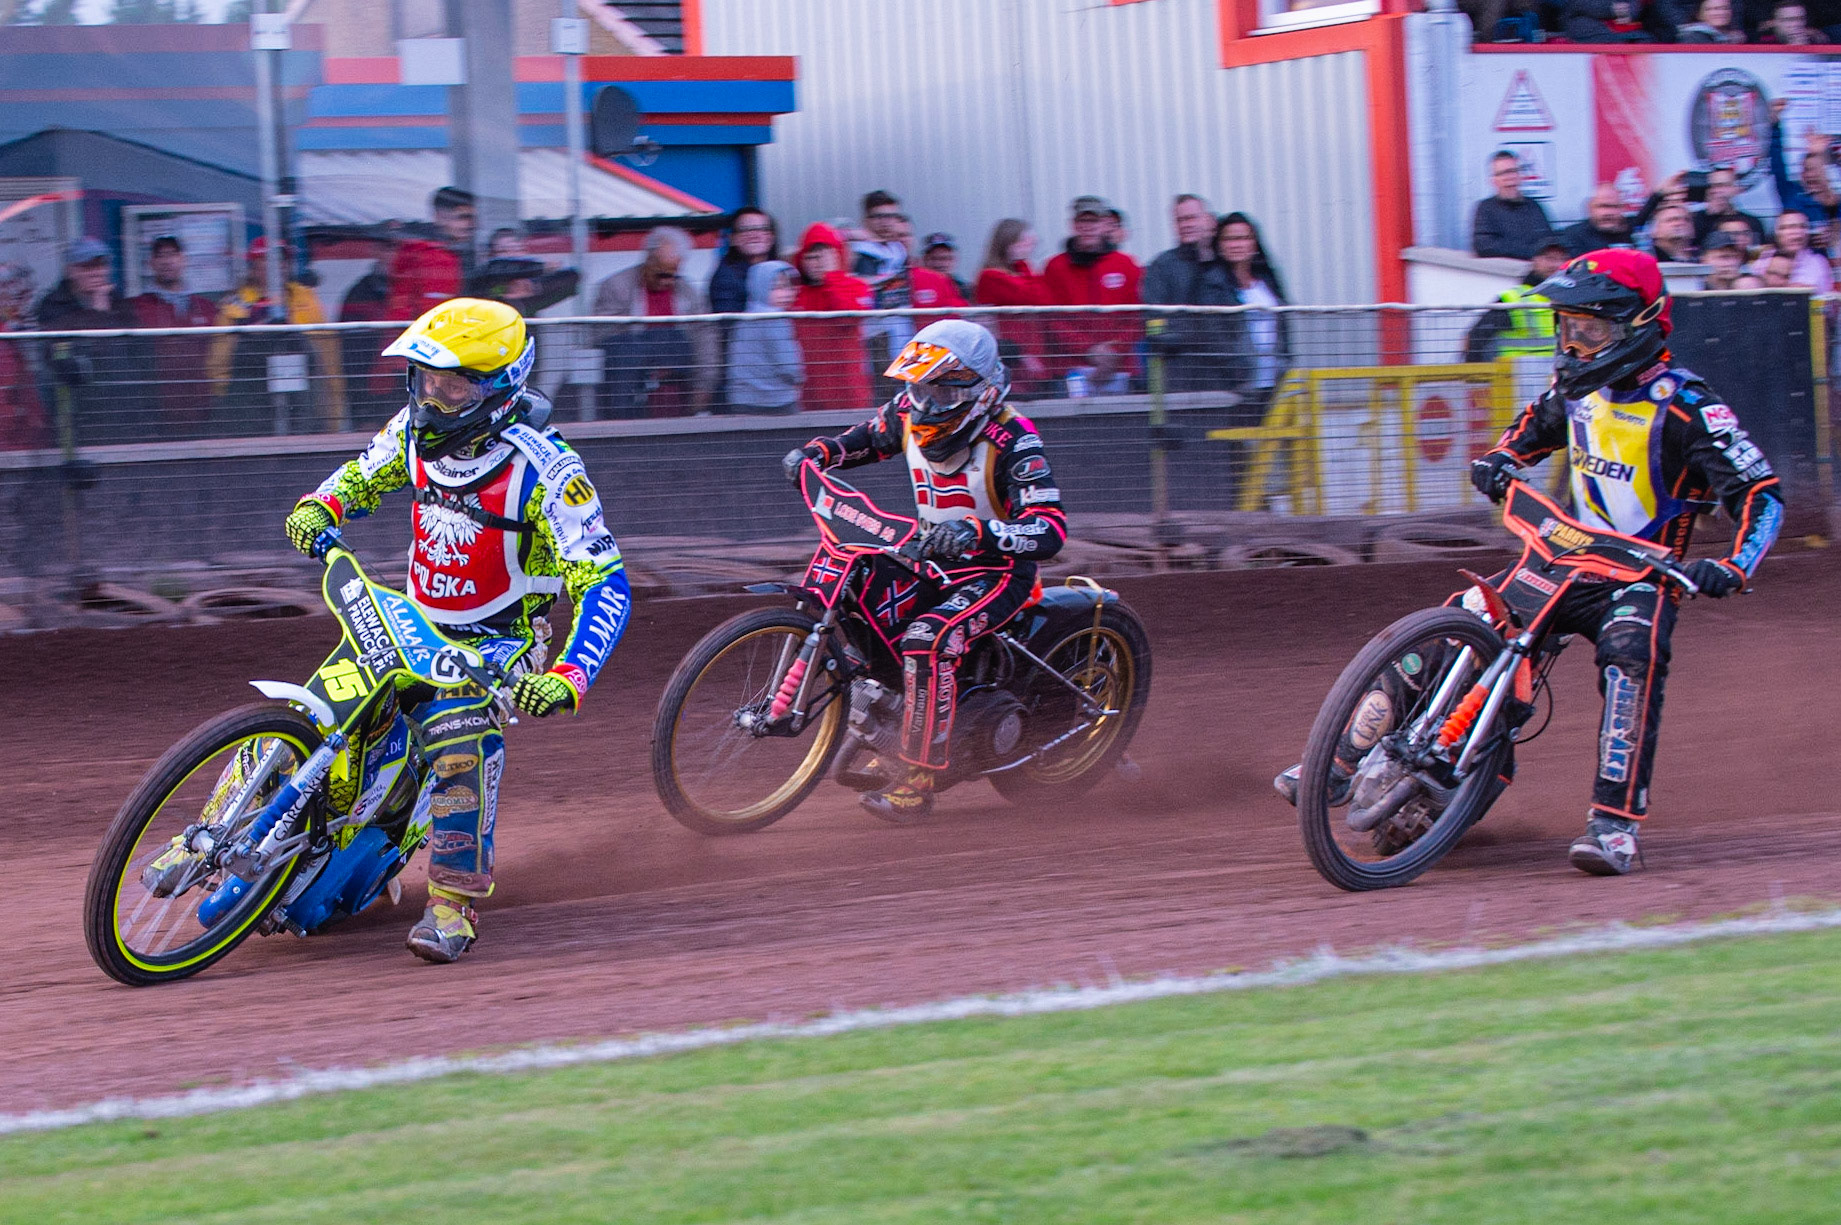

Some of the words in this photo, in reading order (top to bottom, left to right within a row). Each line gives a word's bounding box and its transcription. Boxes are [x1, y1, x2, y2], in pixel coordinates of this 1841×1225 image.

[432, 460, 480, 480] Stainer
[554, 472, 574, 499] Nowak
[413, 560, 478, 599] POLSKA
[357, 595, 397, 667] ELEWACE-
[386, 595, 431, 663] ALMAR
[577, 586, 626, 678] ALMAR
[318, 657, 370, 703] 15
[428, 716, 491, 736] TRANS-KOM
